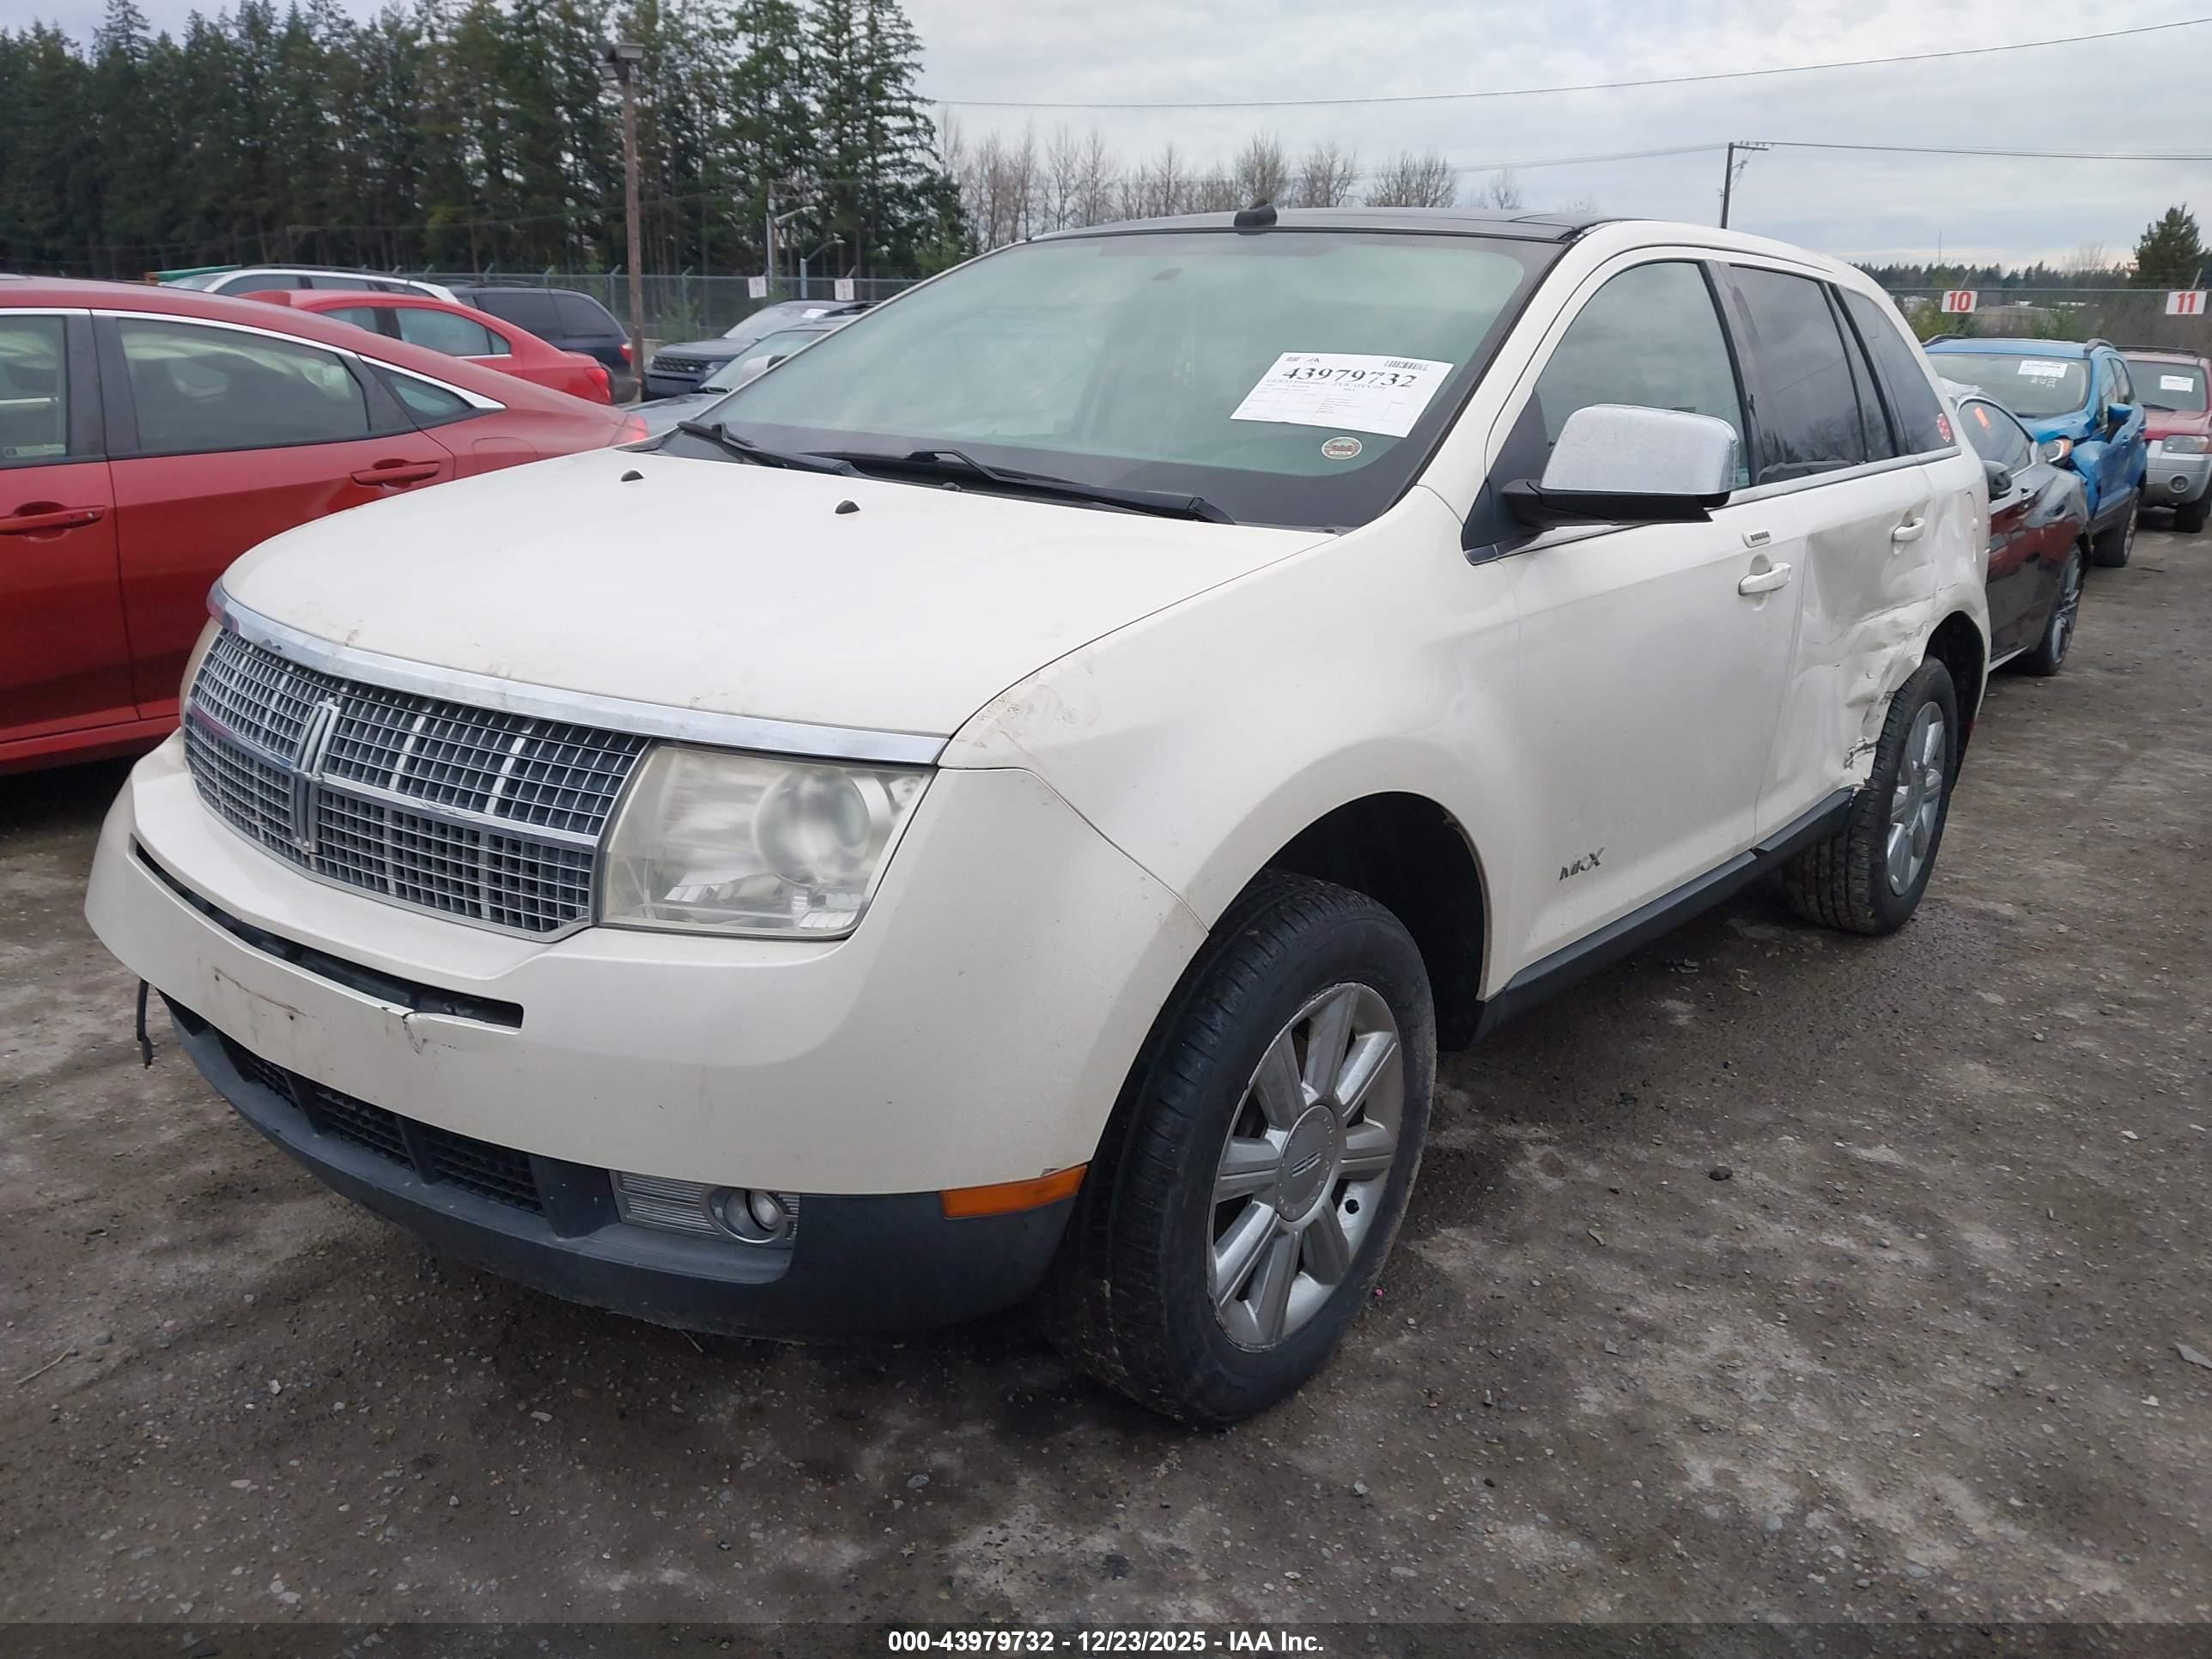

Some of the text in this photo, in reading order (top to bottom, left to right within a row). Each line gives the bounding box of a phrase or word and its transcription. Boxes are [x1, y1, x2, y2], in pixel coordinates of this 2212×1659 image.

[1950, 292, 1972, 311] 10
[2177, 293, 2197, 313] 11
[1283, 368, 1418, 388] 43979732
[1559, 847, 1605, 881] MKX
